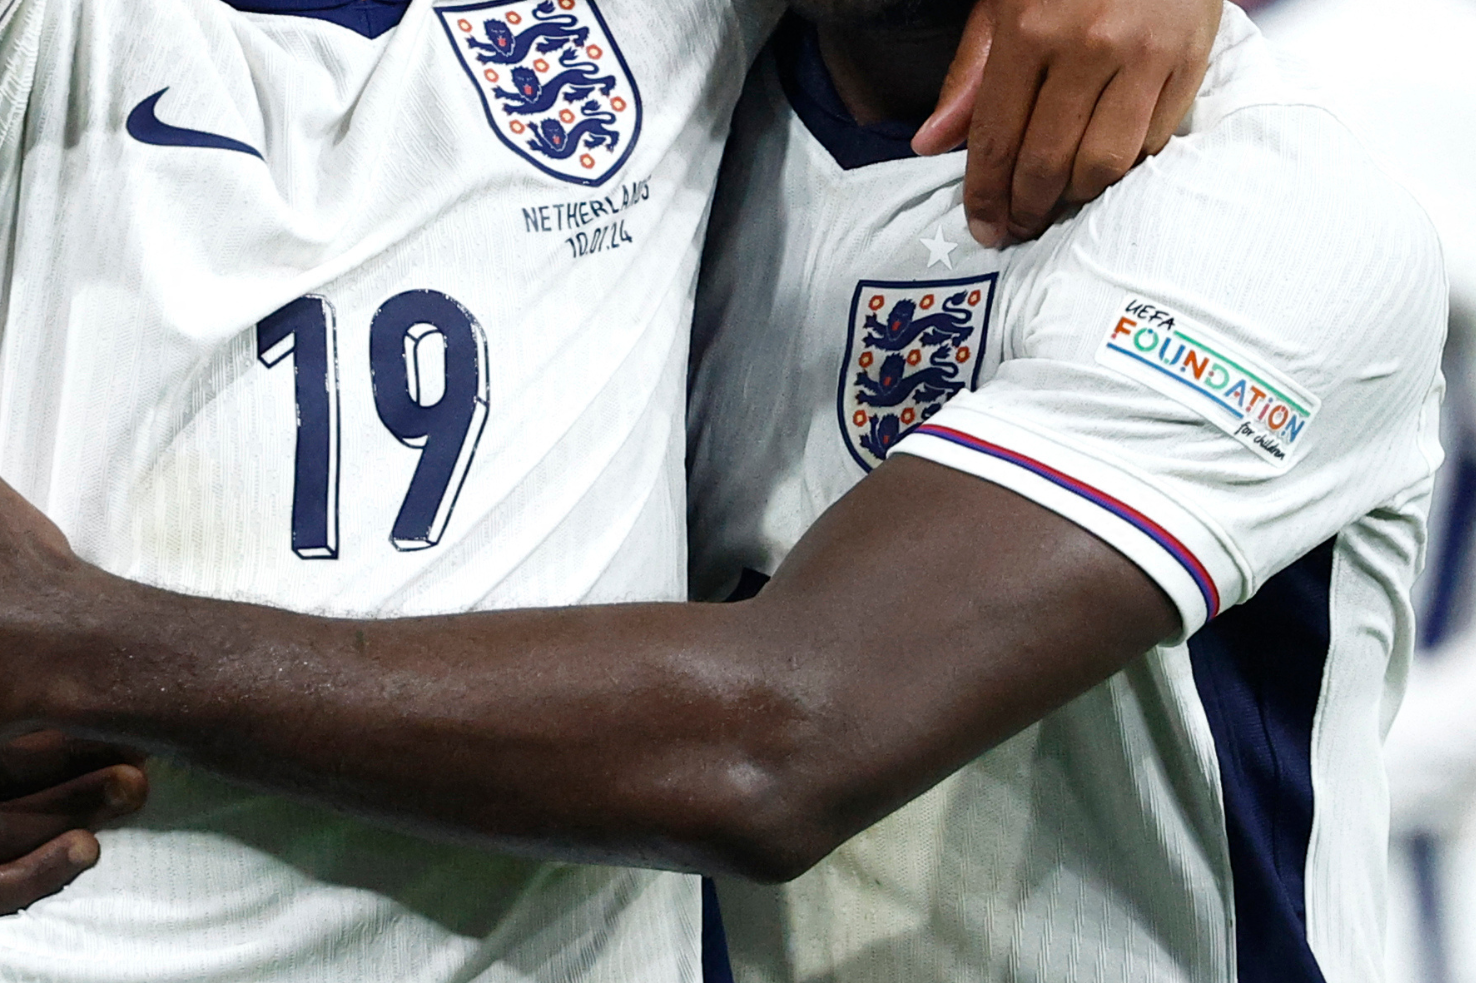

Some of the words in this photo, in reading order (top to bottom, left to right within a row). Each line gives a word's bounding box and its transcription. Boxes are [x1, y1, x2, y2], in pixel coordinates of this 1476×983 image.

[1125, 299, 1176, 331] UEFA
[1111, 316, 1306, 443] FOUNDATION
[256, 288, 490, 560] 19
[1234, 421, 1255, 437] for
[1252, 434, 1286, 461] children
